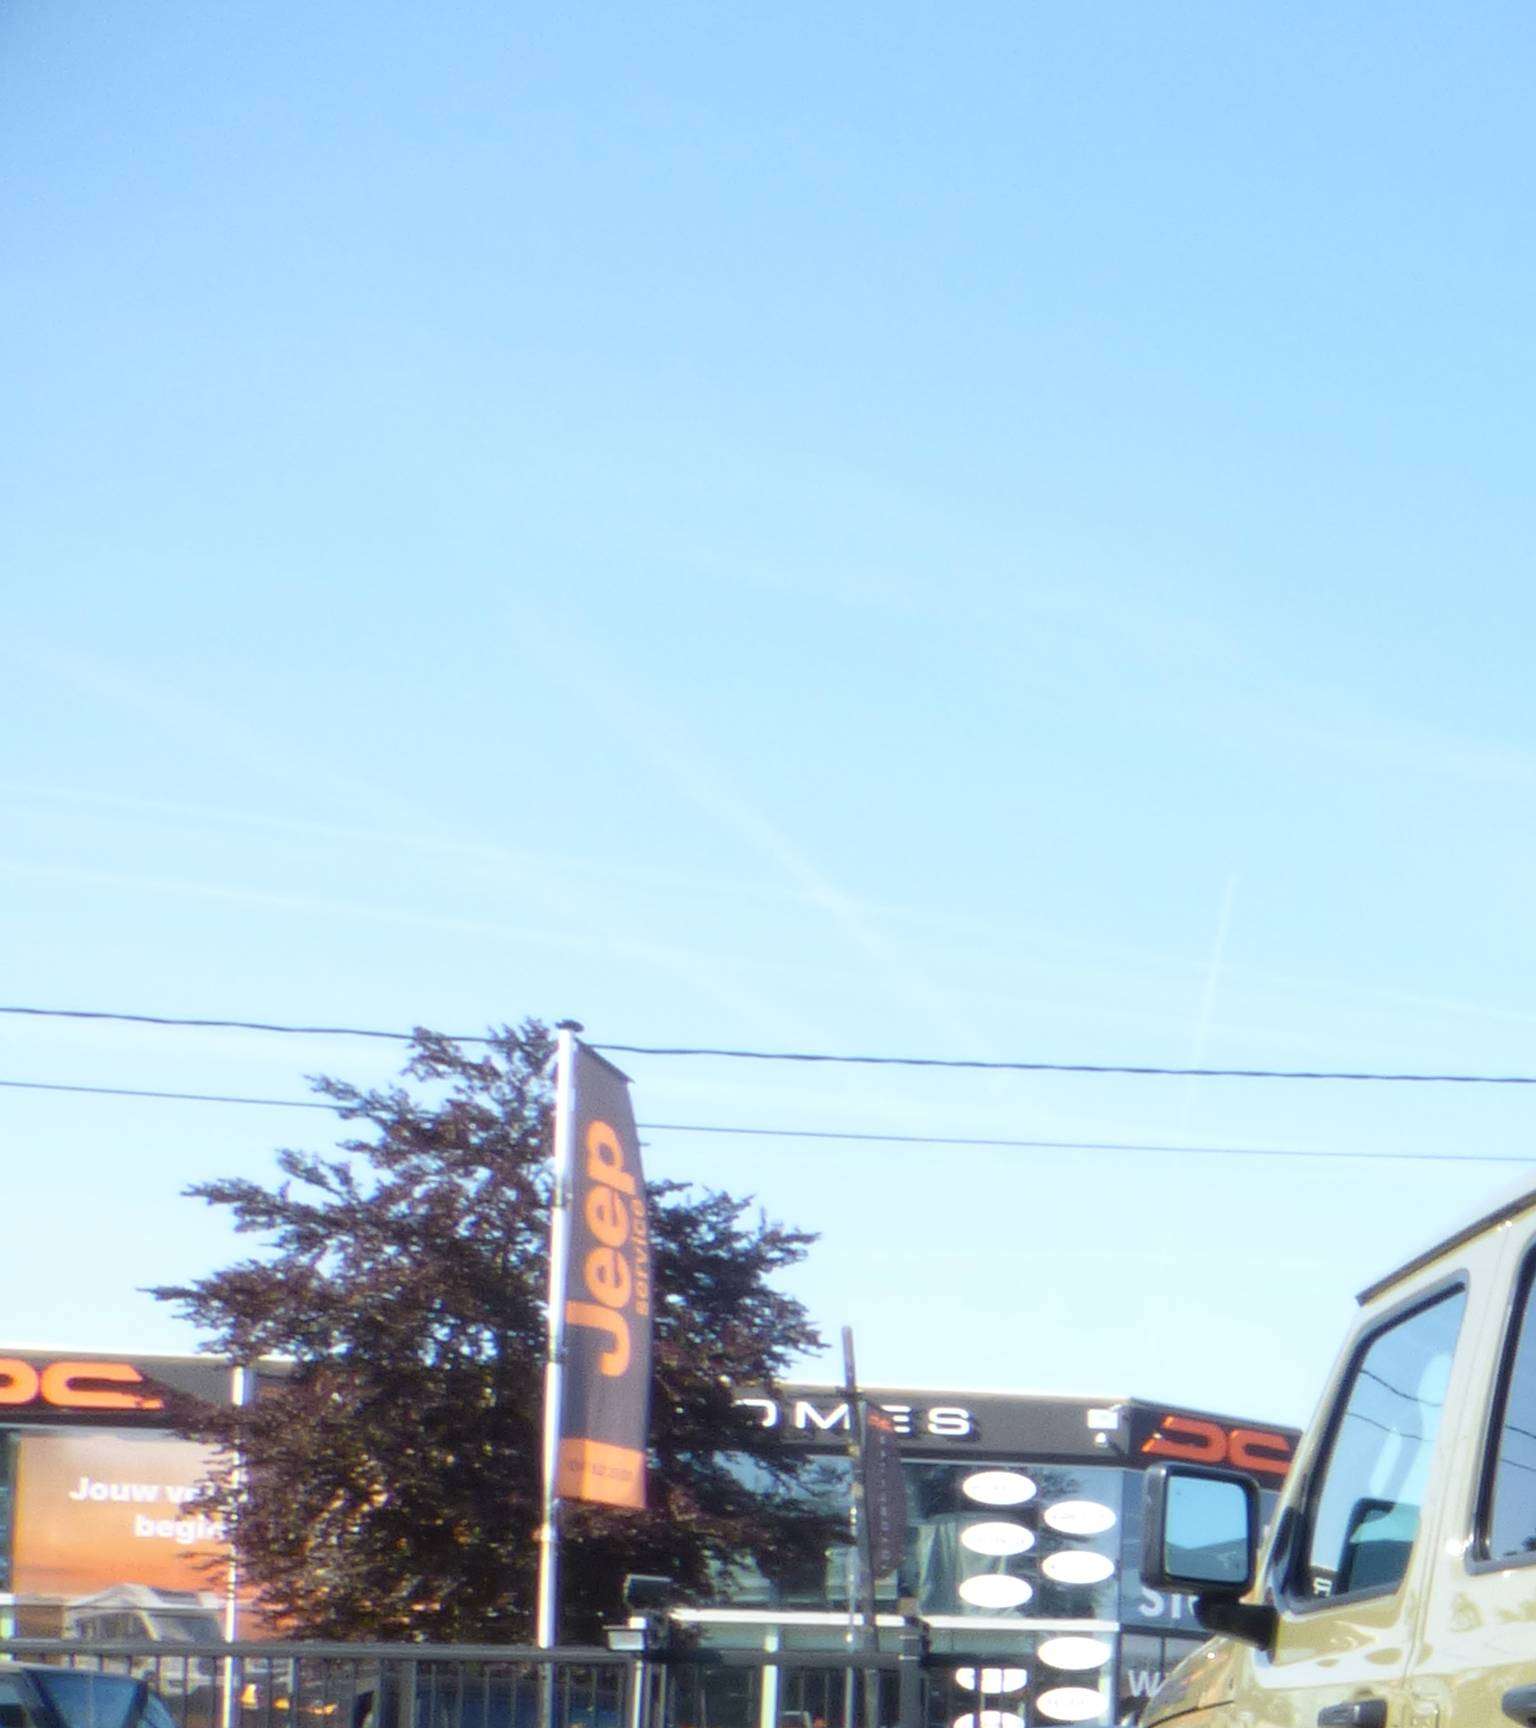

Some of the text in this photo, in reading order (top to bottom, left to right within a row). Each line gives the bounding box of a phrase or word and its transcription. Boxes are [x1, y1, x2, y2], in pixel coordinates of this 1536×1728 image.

[564, 1119, 636, 1378] Jeep
[633, 1198, 649, 1316] service
[69, 1476, 159, 1501] Jouw
[1141, 1415, 1292, 1474] DC
